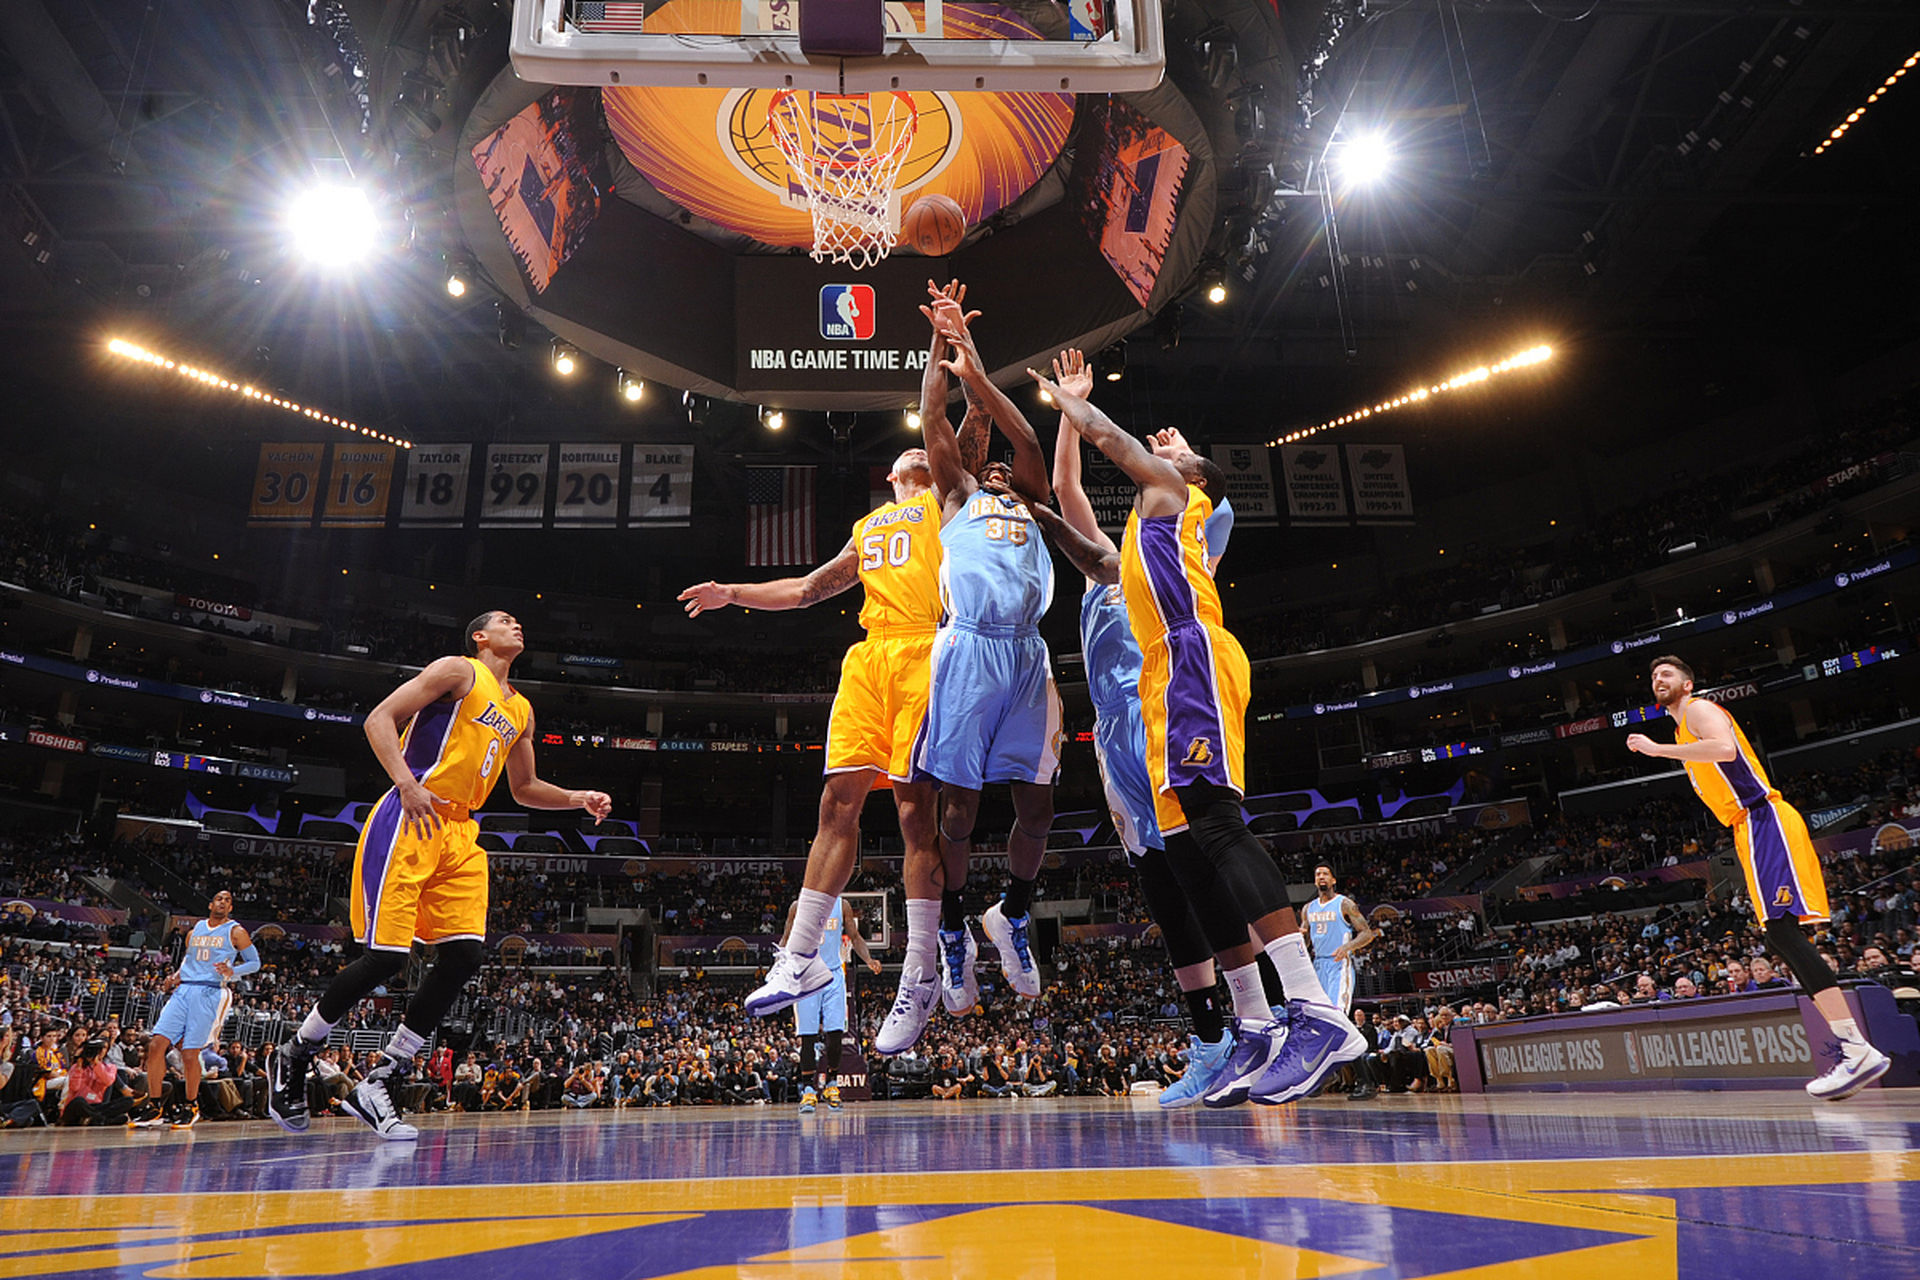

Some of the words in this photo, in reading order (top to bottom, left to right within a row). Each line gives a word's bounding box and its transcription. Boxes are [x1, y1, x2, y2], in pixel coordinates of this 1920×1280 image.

[826, 323, 850, 336] NBA
[751, 350, 787, 370] NBA
[790, 350, 847, 370] GAME
[851, 350, 900, 370] TIME
[904, 350, 931, 370] AP
[268, 453, 314, 462] VACHON
[341, 453, 386, 462] DIONNE
[418, 453, 461, 463] TAYLOR
[491, 453, 543, 464] GRETZKY
[561, 453, 619, 464] ROBITAILLE
[645, 454, 682, 464] BLAKE
[258, 472, 309, 505] 30
[337, 472, 376, 506] 16
[415, 473, 454, 505] 18
[490, 472, 539, 506] 99
[562, 473, 612, 505] 20
[648, 473, 672, 505] 4
[1084, 486, 1116, 495] ANLEY
[1117, 486, 1137, 495] CUP
[1227, 482, 1270, 490] NFERENCE
[1290, 482, 1340, 490] CONFERENCE
[1227, 491, 1269, 499] HAMPIONS
[1293, 491, 1340, 499] CHAMPIONS
[1359, 490, 1405, 498] CHAMPIONS
[1090, 496, 1134, 506] AMPION
[1299, 502, 1337, 511] 1992-93
[1094, 509, 1129, 522] 011-12
[985, 517, 1027, 545] 35
[863, 530, 911, 571] 50
[1850, 561, 1891, 582] Prudential
[188, 597, 239, 617] TOYOTA
[29, 732, 84, 751] TOSHIBA
[671, 741, 704, 750] DELTA
[711, 741, 748, 752] STAPLES
[480, 738, 500, 779] 6
[1371, 753, 1414, 768] STAPLES
[253, 769, 291, 781] DELTA
[1316, 922, 1328, 934] 21
[196, 948, 210, 962] 10
[1428, 966, 1496, 989] STAPLES
[1641, 1034, 1680, 1068] NBA
[1678, 1028, 1752, 1066] LEAGUE
[1752, 1023, 1812, 1063] PASS
[1494, 1045, 1520, 1074] NBA
[1518, 1041, 1567, 1073] LEAGUE
[1566, 1039, 1604, 1070] PASS
[836, 1074, 851, 1087] BA
[851, 1074, 866, 1087] TV
